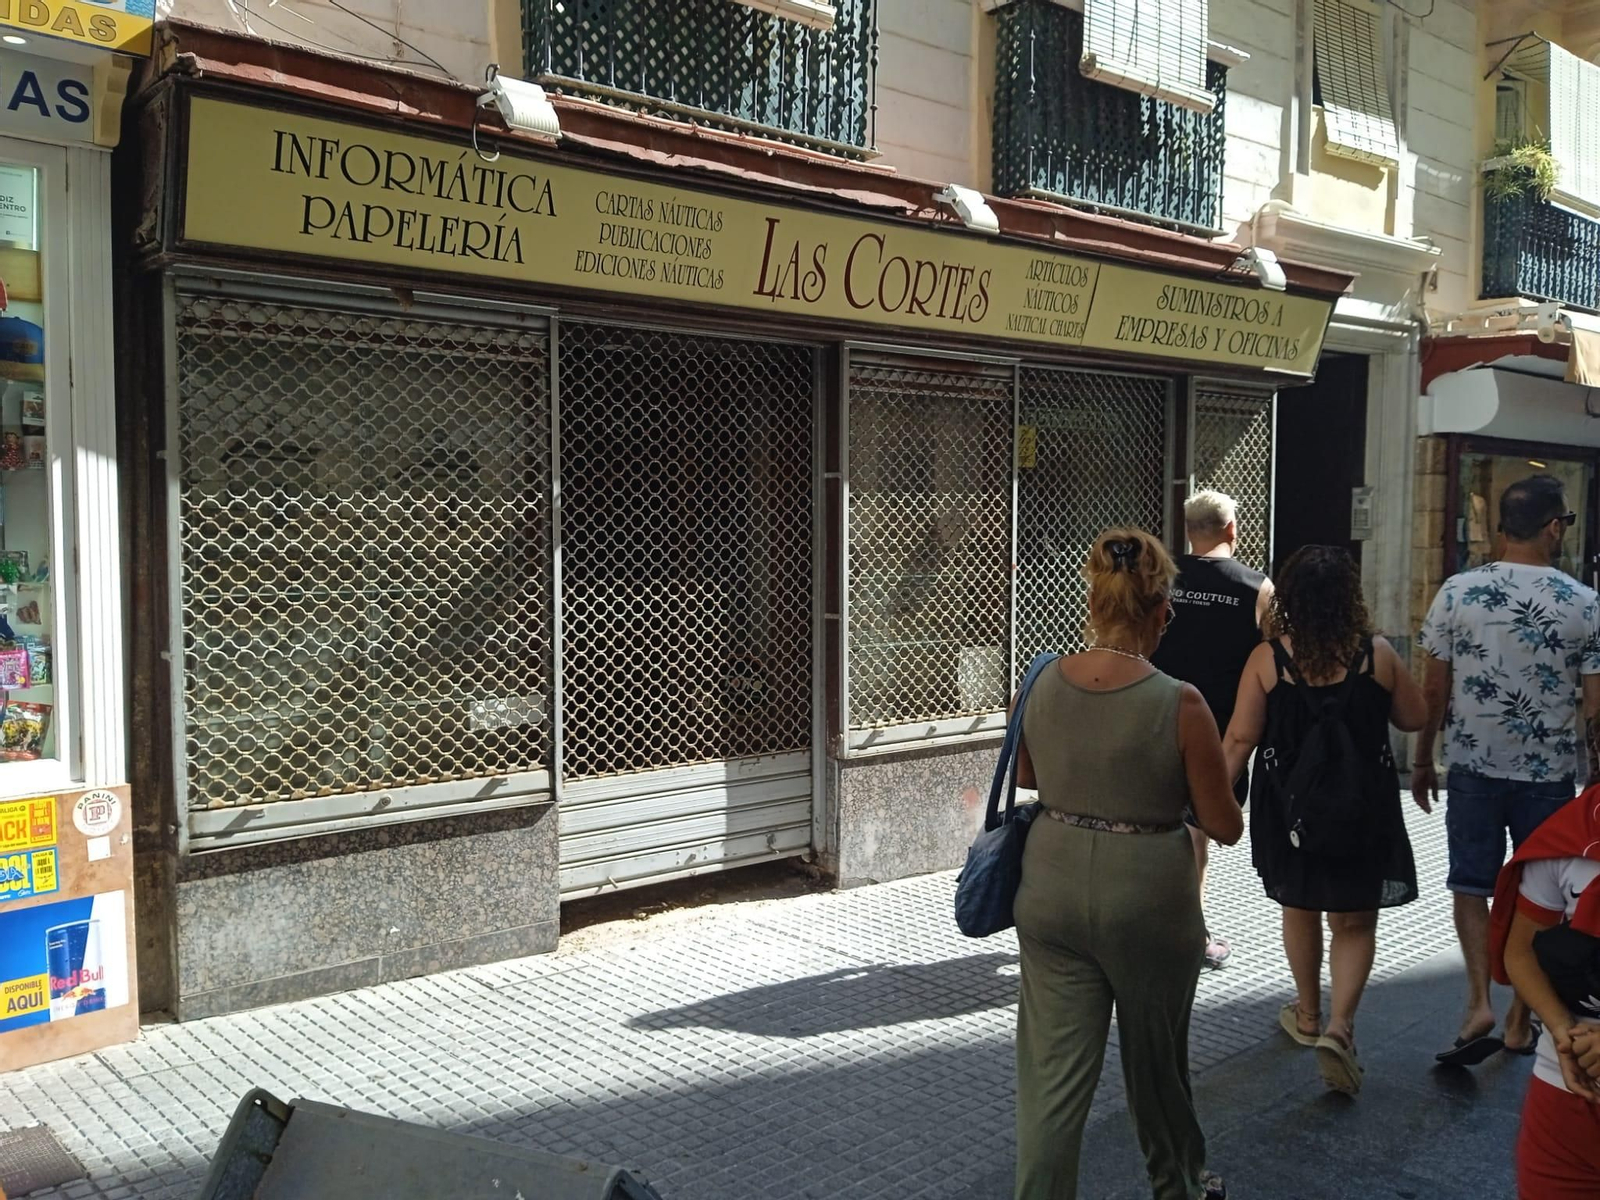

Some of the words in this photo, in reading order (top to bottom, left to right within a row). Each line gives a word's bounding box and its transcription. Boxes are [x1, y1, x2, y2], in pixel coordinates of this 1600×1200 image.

[270, 129, 557, 217] INFORMÁTICA
[595, 190, 654, 221] CARTAS
[658, 196, 723, 232] NÁUTICAS
[299, 194, 525, 264] PAPELERÍA
[598, 222, 712, 260] PUBLICACIONES
[574, 249, 656, 281] EDICIONES
[659, 256, 724, 290] NÁUTICAS
[752, 217, 828, 303] LAS
[844, 233, 992, 324] CORTES
[1025, 255, 1089, 288] ARTÍCULOS
[1023, 282, 1079, 315] NÁUTICOS
[1156, 284, 1270, 325] SUMINISTROS
[1271, 303, 1284, 328] A
[1005, 313, 1048, 335] NAUTICAL
[1049, 318, 1085, 339] CHARTS
[1114, 314, 1209, 350] EMPRESAS
[1213, 327, 1226, 351] Y
[1228, 330, 1300, 361] OFICINAS
[1186, 590, 1240, 607] COUTURE
[77, 792, 116, 810] PANINI
[5, 979, 42, 995] DISPONIBLE
[50, 969, 78, 991] Red
[80, 965, 104, 984] Bull
[7, 987, 43, 1014] AQUÍ
